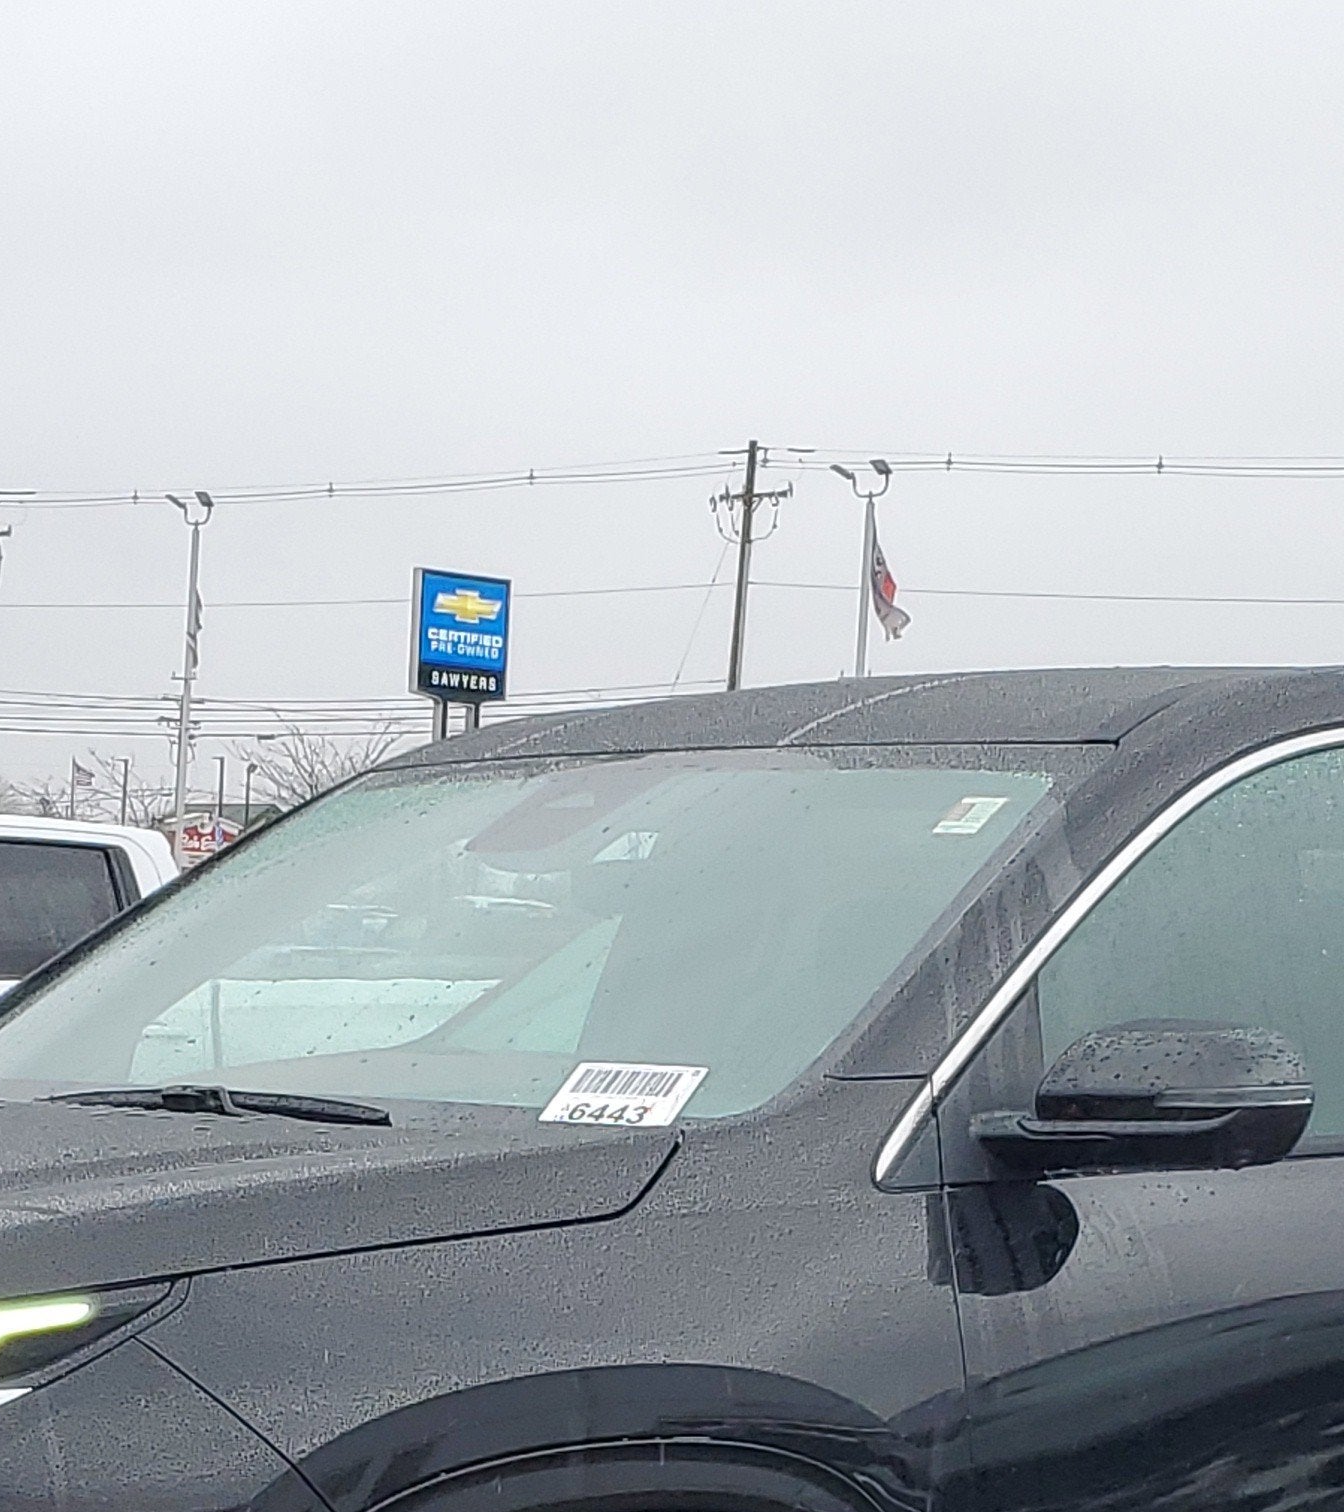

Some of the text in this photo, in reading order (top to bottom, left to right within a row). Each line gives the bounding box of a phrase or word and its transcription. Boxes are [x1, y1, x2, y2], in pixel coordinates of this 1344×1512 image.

[428, 627, 503, 648] CERTIFIED
[431, 640, 499, 660] PRE-OWNED
[431, 670, 497, 691] SAWYERS
[567, 1102, 648, 1124] 6443
